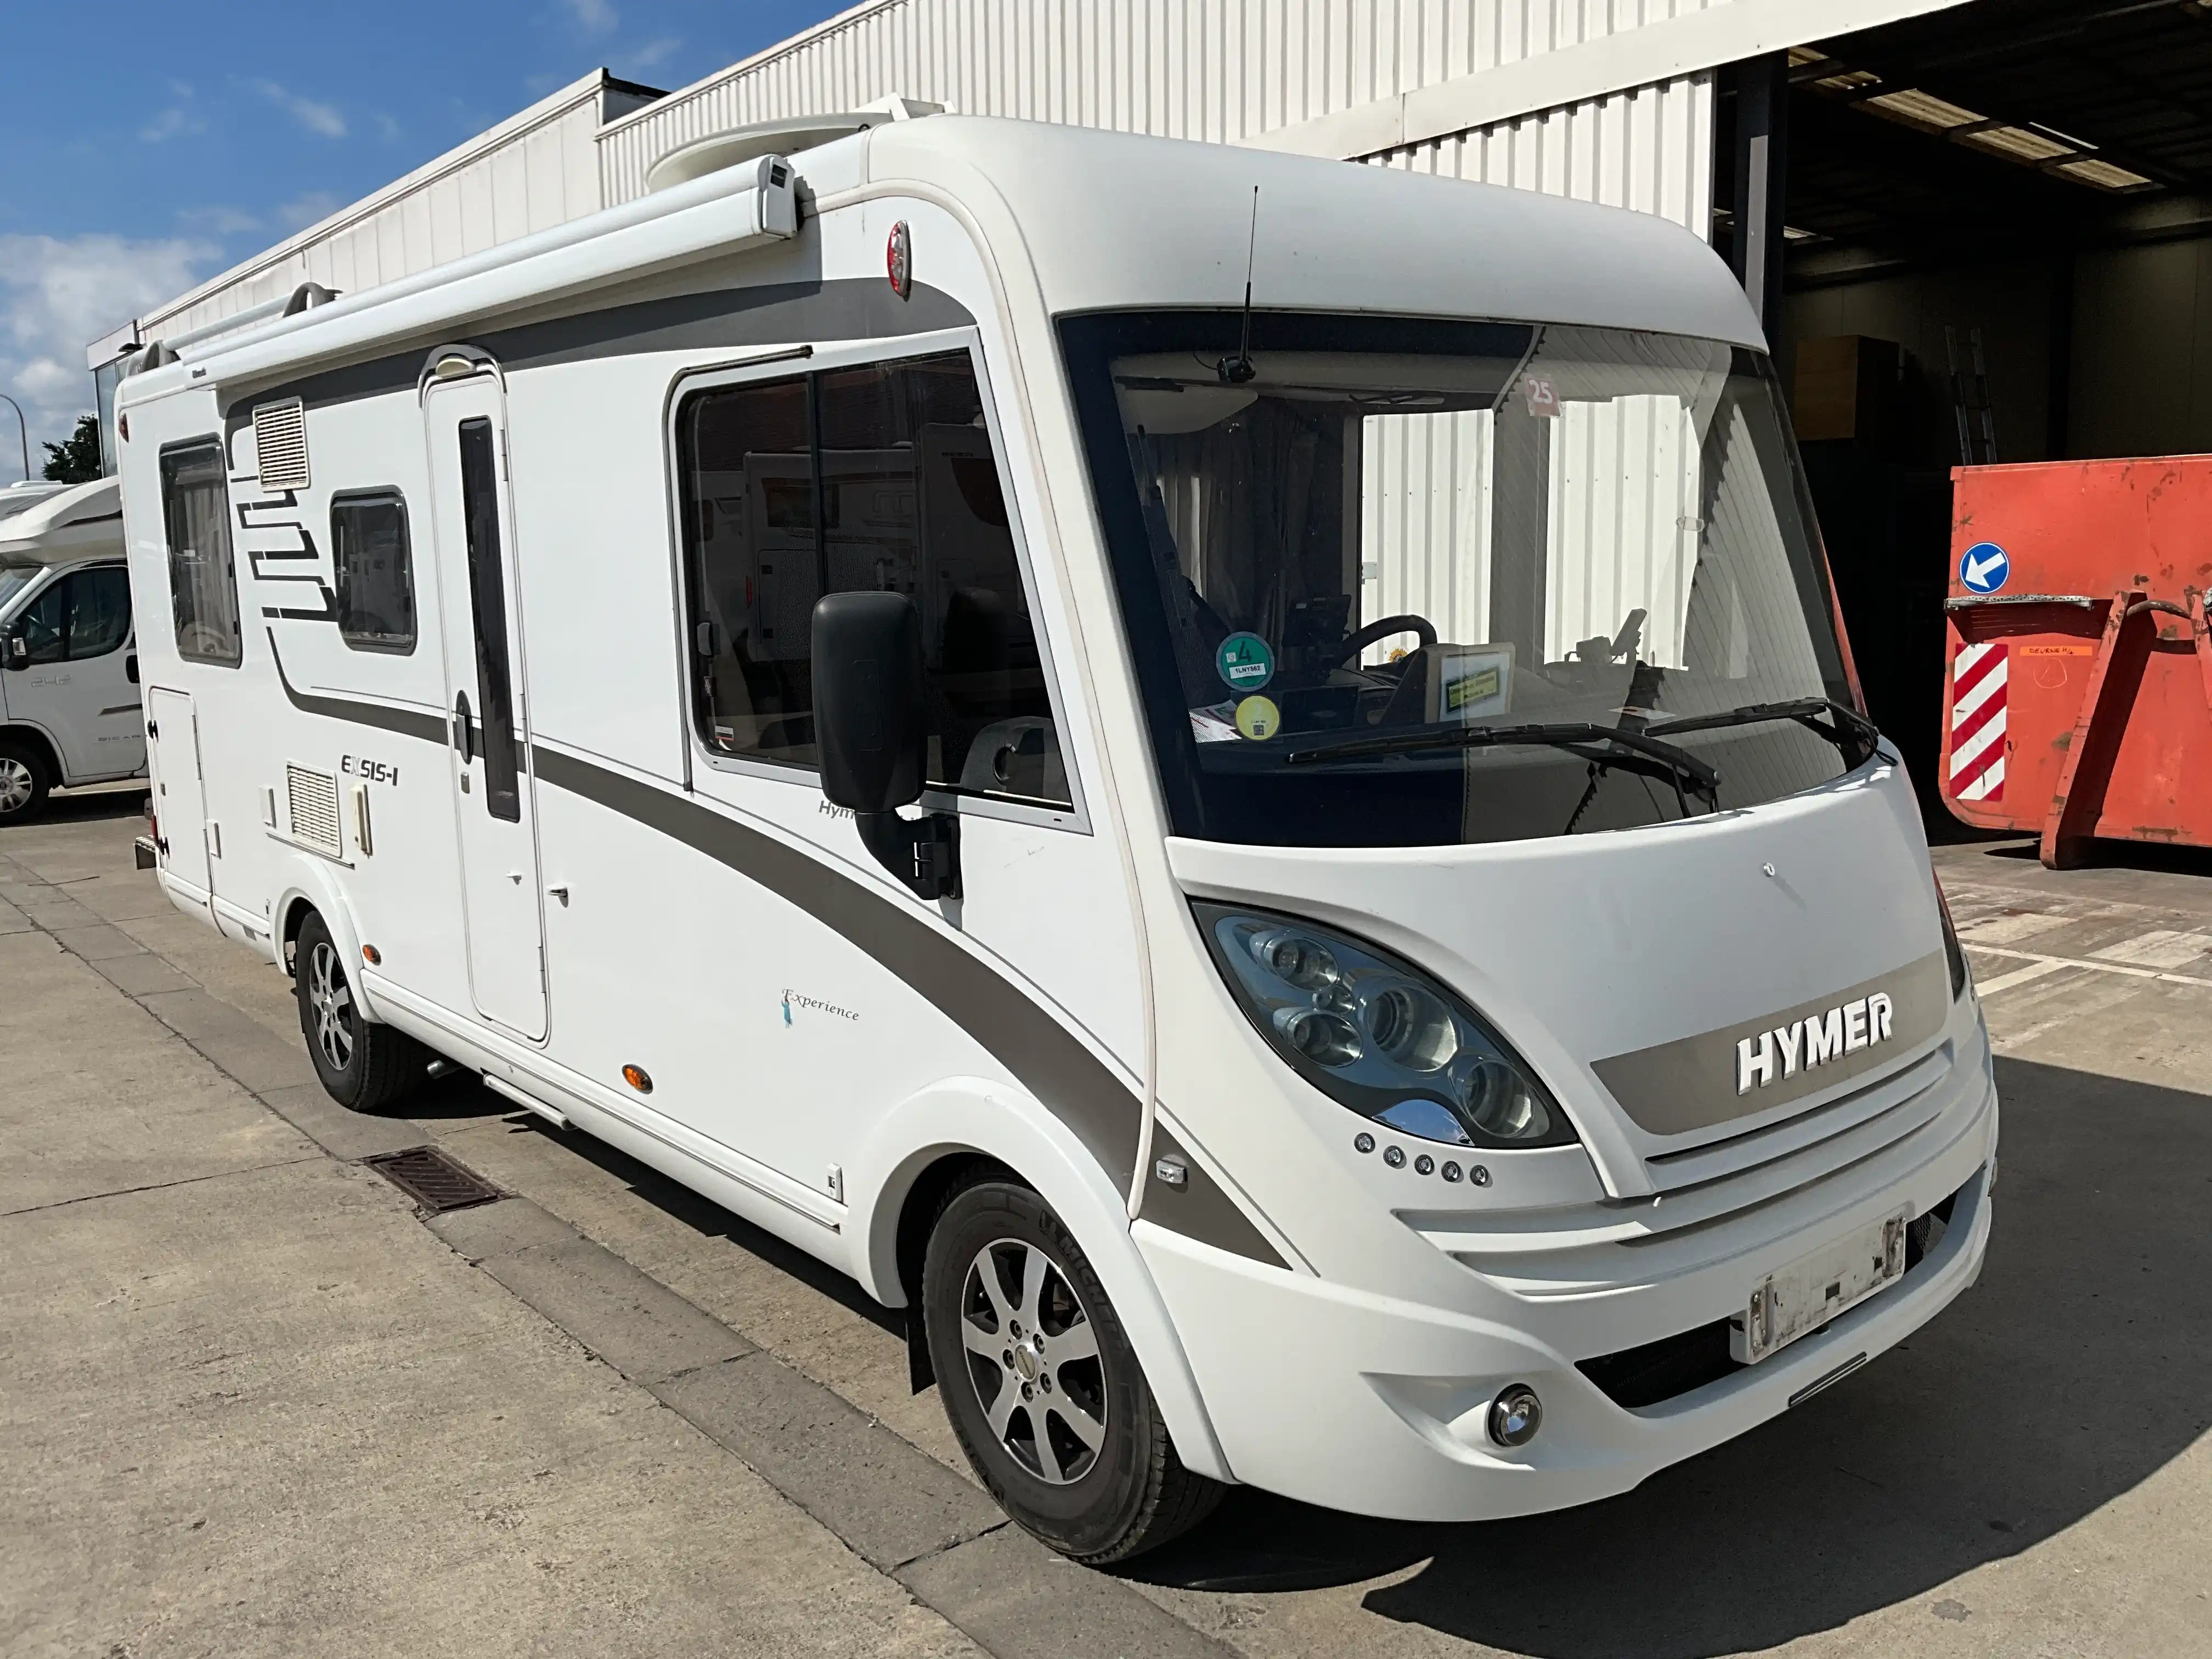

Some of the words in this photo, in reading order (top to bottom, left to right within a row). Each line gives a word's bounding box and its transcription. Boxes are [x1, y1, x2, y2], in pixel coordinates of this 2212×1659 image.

[1528, 379, 1553, 404] 25
[1238, 641, 1252, 662] 4
[782, 988, 859, 1020] Experience
[1736, 992, 1893, 1096] HYMER
